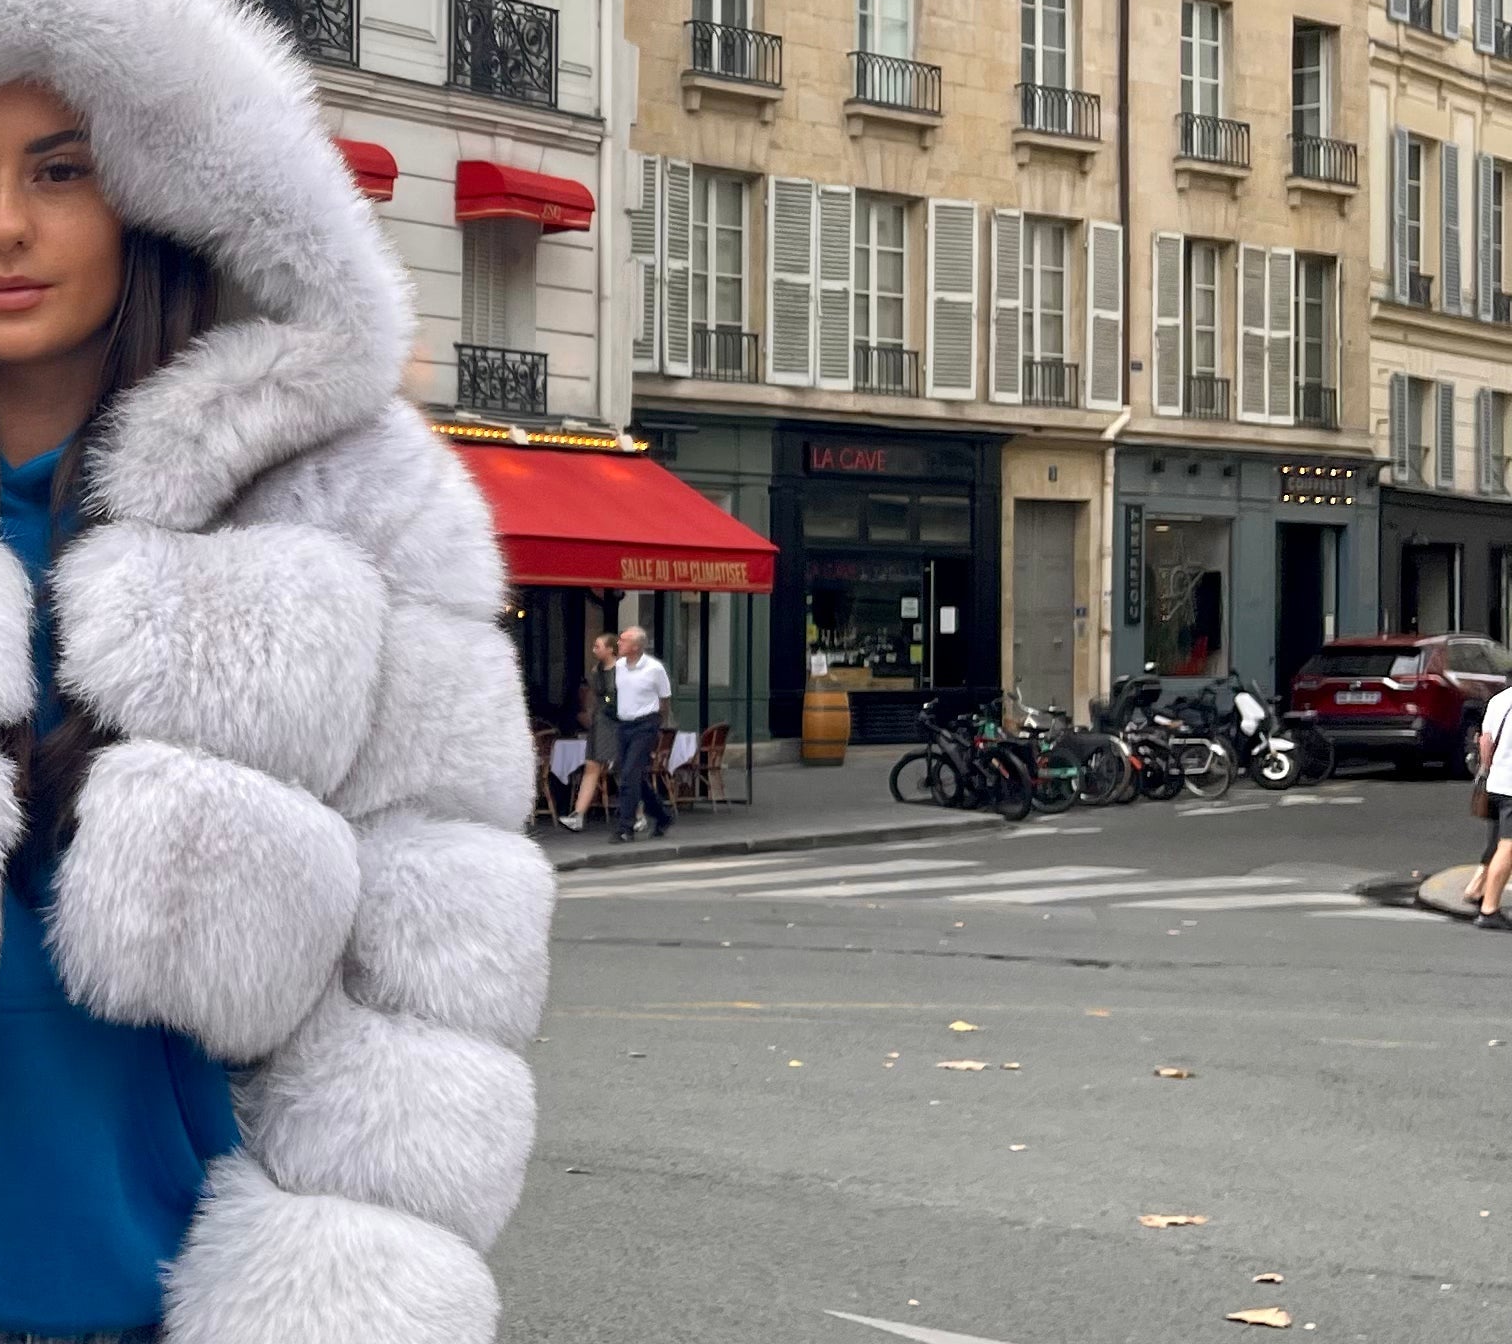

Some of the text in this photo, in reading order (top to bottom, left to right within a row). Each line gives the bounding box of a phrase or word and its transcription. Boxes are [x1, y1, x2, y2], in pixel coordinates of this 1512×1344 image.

[813, 447, 887, 472] LA CAVE
[620, 558, 653, 581] SALLE
[656, 559, 669, 582] AU
